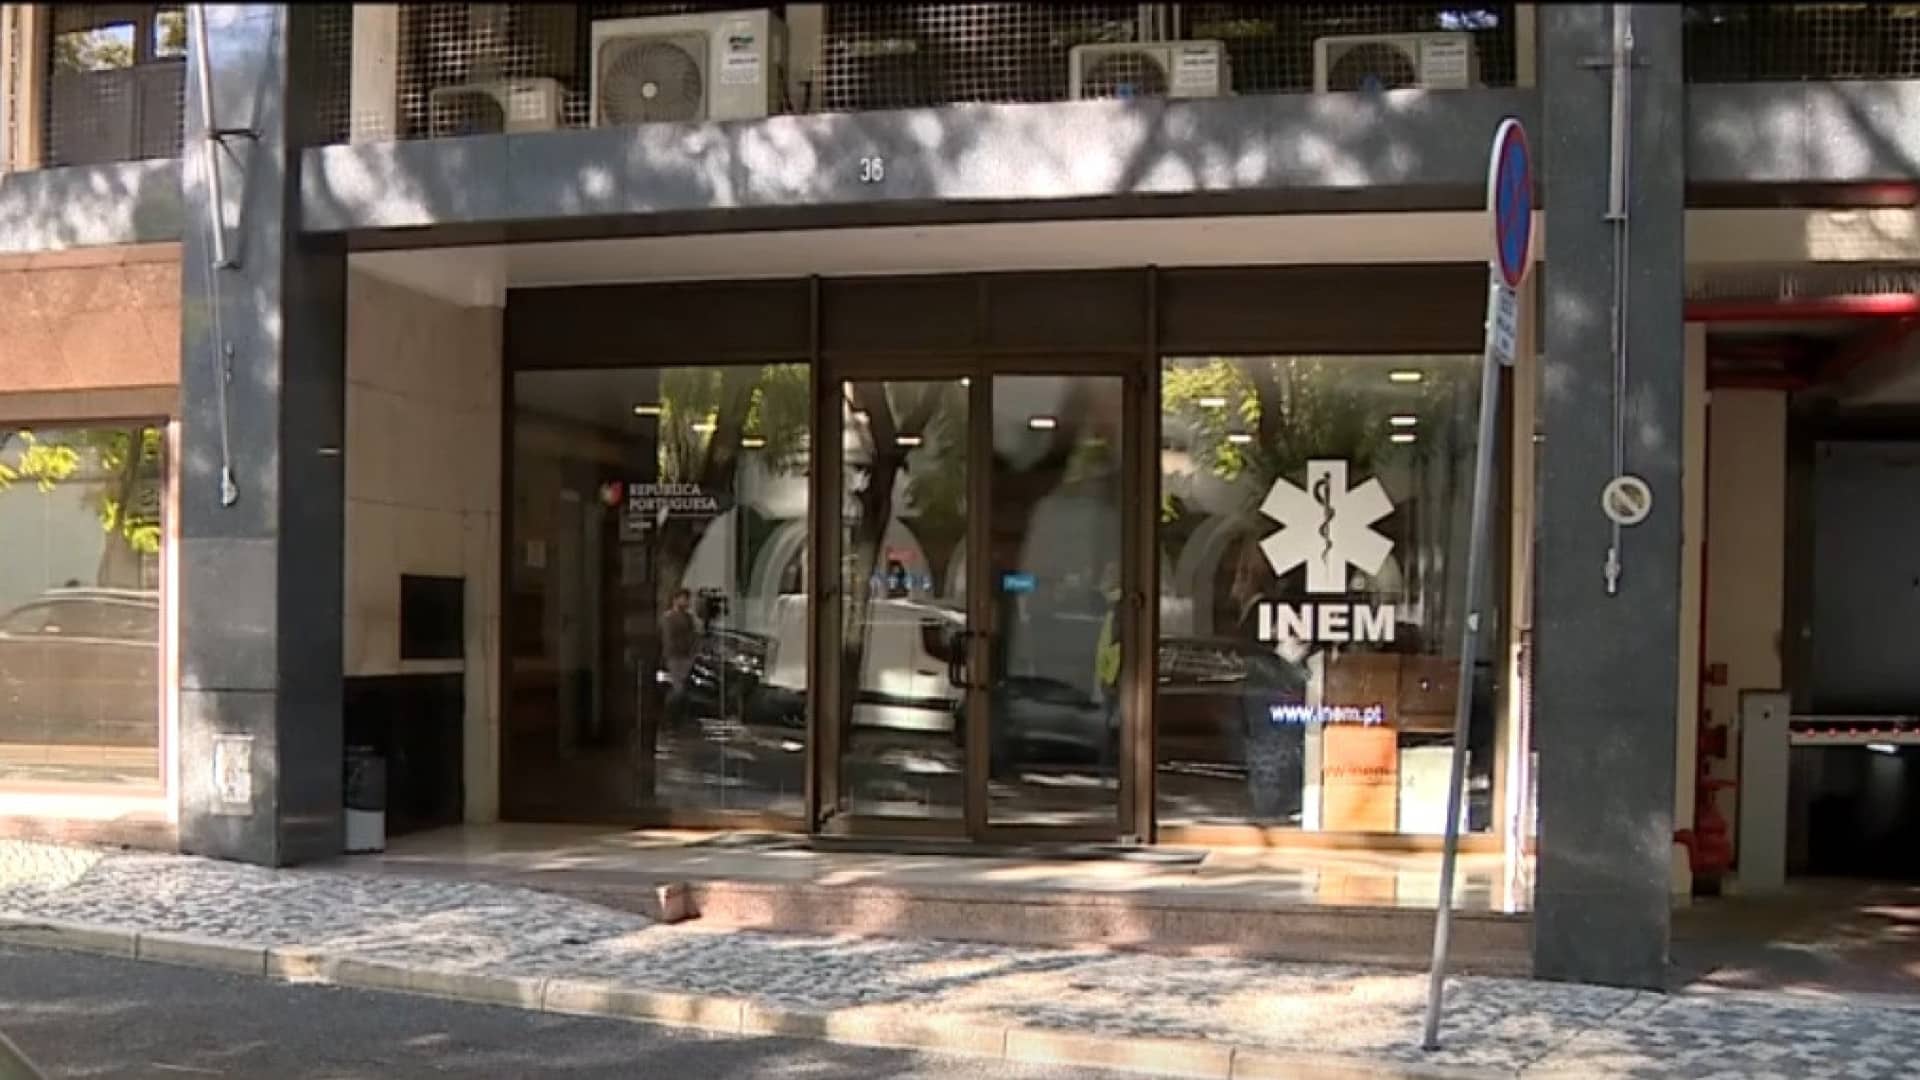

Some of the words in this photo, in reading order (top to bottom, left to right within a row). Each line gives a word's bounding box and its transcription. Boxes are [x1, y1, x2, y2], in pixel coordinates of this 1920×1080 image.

[860, 158, 884, 181] 36
[629, 497, 718, 511] PORTUGUESA
[1258, 602, 1396, 642] INEM
[1269, 703, 1383, 727] www.inem.pt
